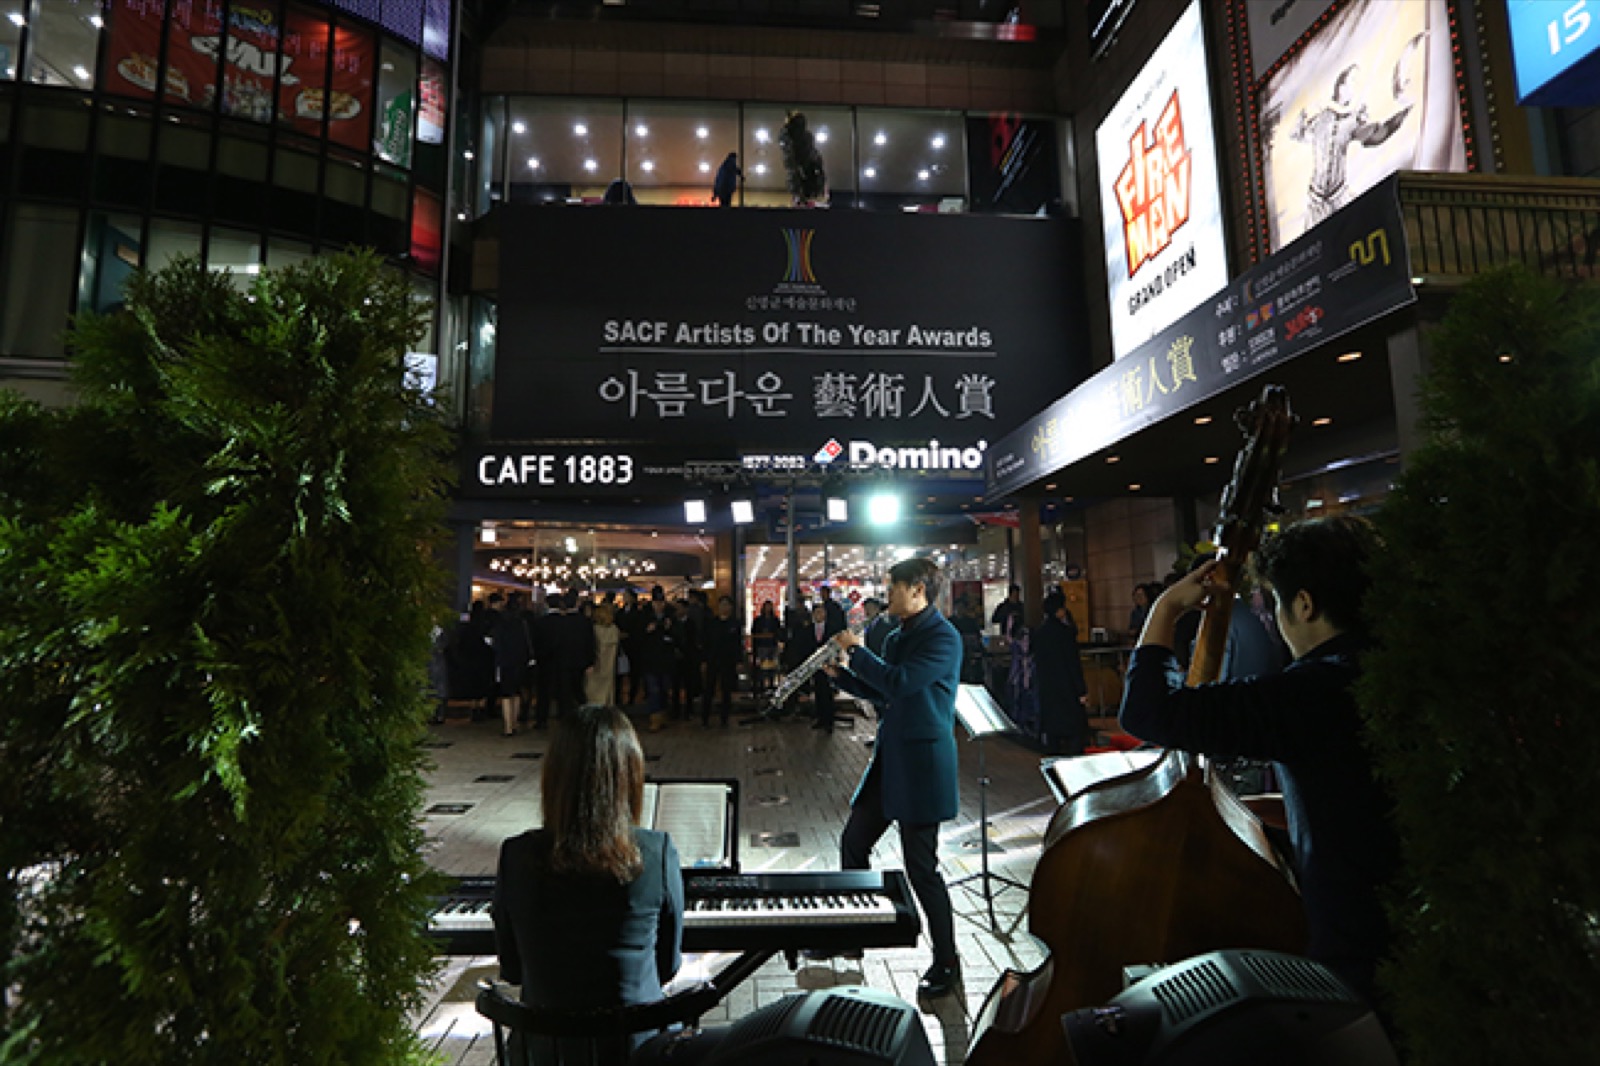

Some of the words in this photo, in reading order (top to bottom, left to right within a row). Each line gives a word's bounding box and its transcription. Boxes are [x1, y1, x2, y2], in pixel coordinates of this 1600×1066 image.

[1548, 0, 1590, 55] 15
[1115, 92, 1184, 220] FIRE
[1126, 155, 1191, 277] MAN
[1163, 241, 1197, 289] OPEN
[603, 320, 668, 343] SACF
[675, 321, 756, 344] Artists
[763, 322, 789, 344] Of
[796, 323, 843, 345] The
[847, 324, 900, 346] Year
[907, 325, 993, 348] Awards
[598, 368, 794, 419] 아름다운
[813, 371, 997, 420] 藝術人賞
[479, 454, 556, 486] CAFE
[564, 454, 634, 485] 1883
